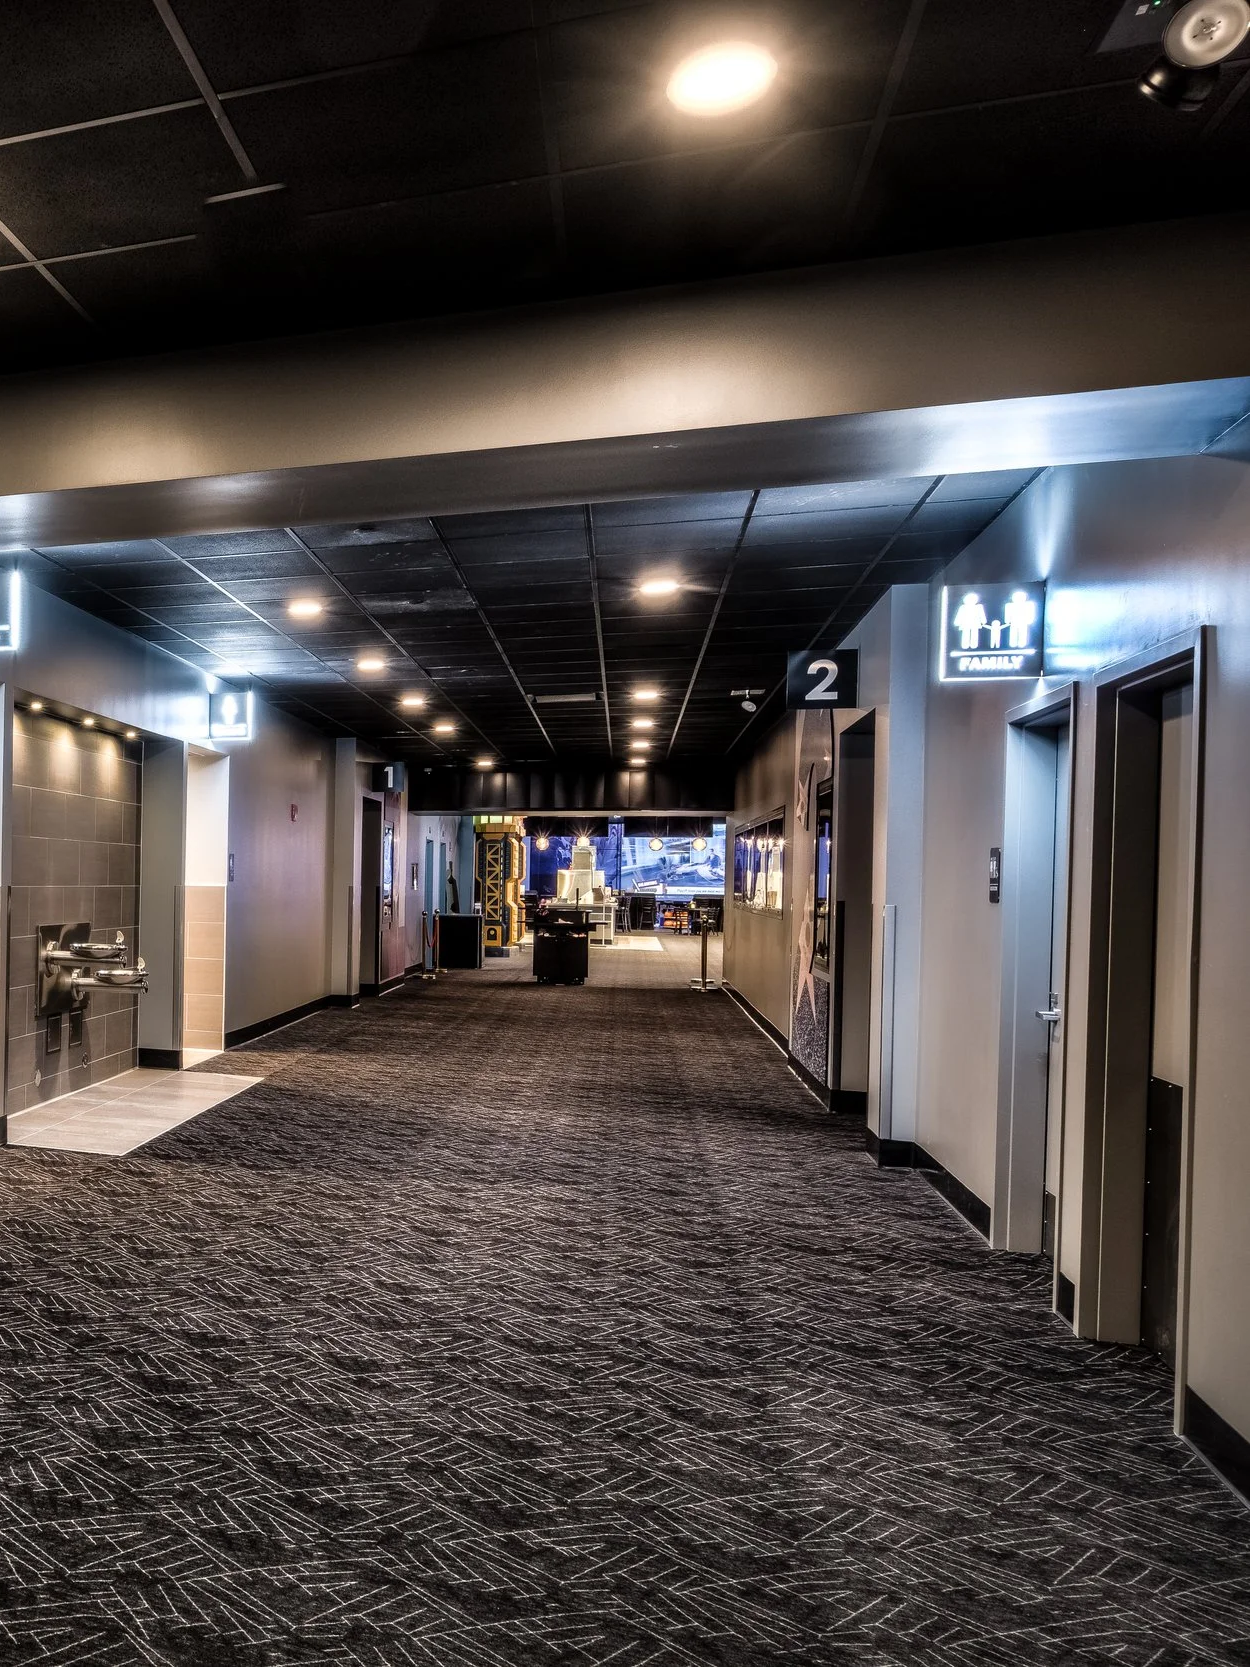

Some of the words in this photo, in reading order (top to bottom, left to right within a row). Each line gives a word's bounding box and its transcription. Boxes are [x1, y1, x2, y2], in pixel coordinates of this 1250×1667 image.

[958, 655, 1024, 671] FAMILY
[805, 658, 838, 701] 2
[383, 766, 394, 788] 1
